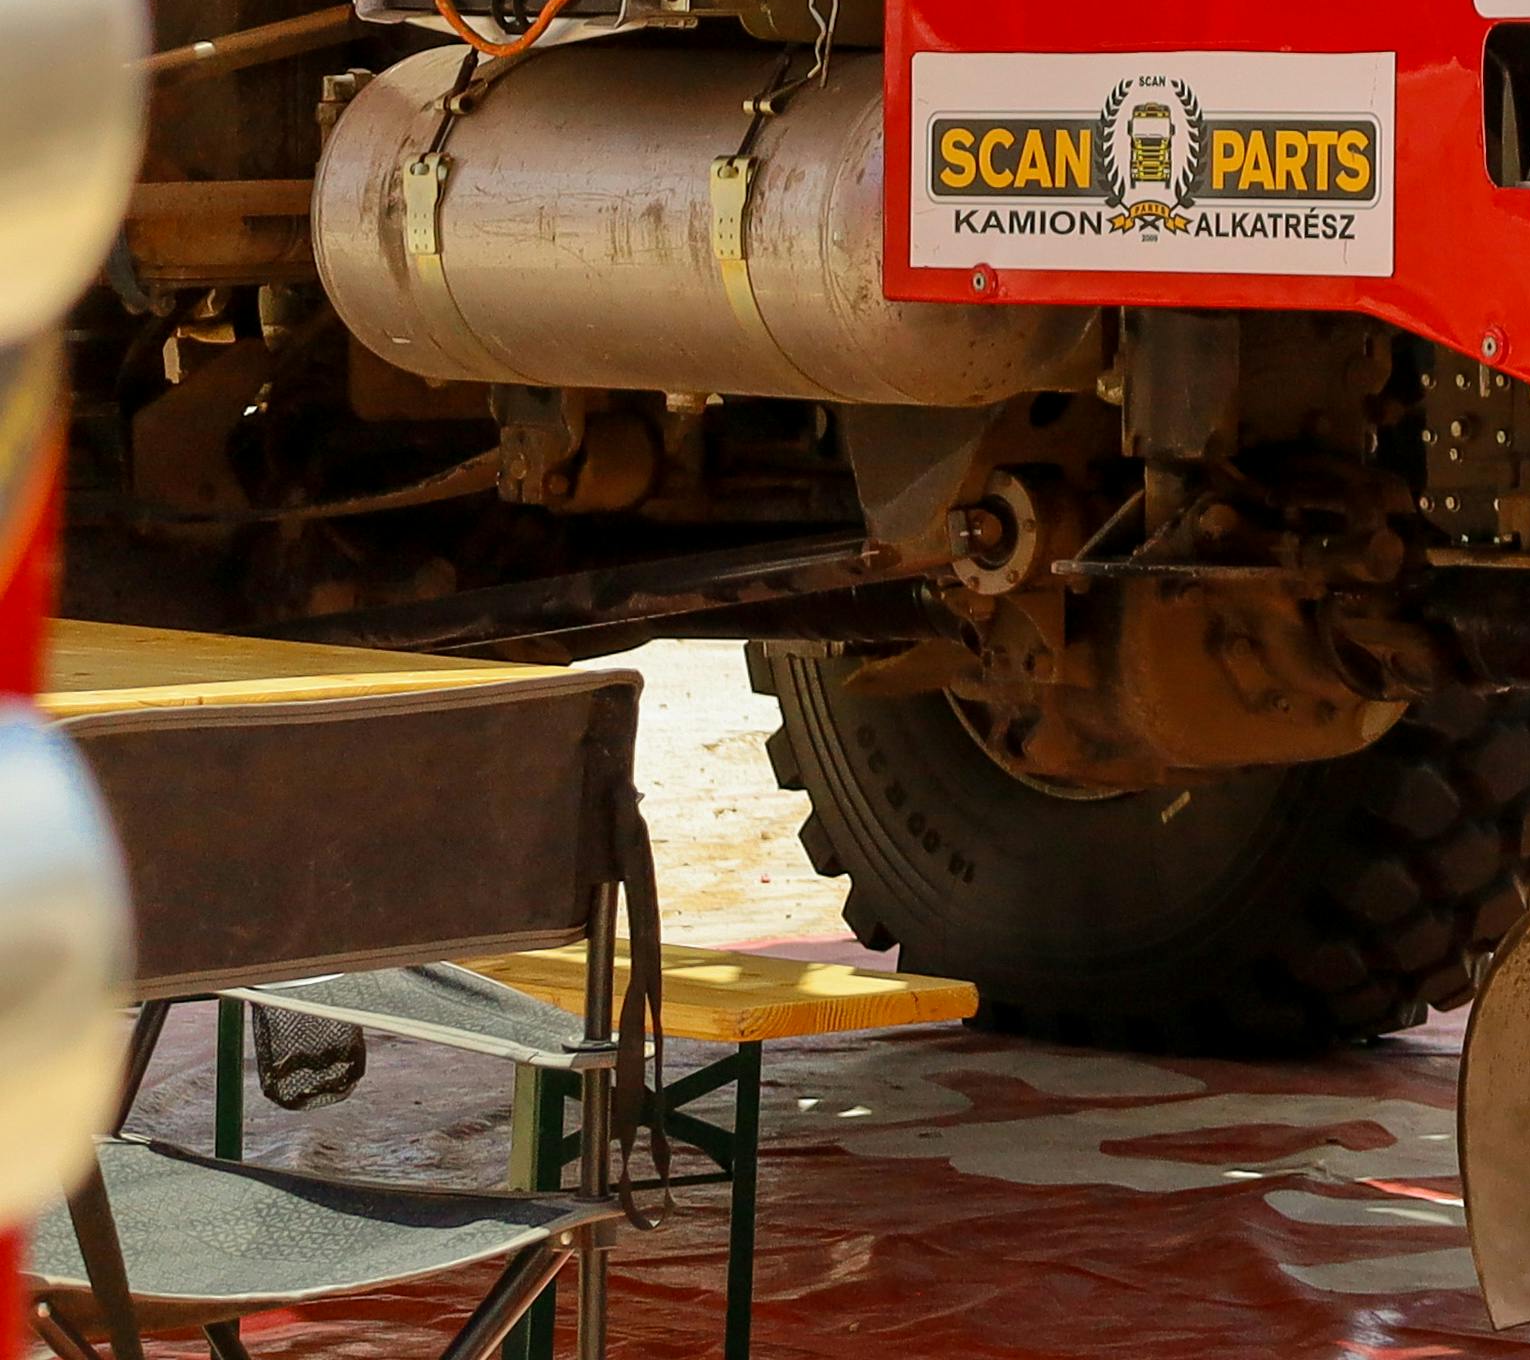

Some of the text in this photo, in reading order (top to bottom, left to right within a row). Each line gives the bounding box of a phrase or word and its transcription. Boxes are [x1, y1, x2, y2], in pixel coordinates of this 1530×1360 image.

[1138, 76, 1166, 87] SCAN
[940, 127, 1372, 193] SCAN PARTS
[954, 206, 1356, 241] KAMION ALKATRÉSZ
